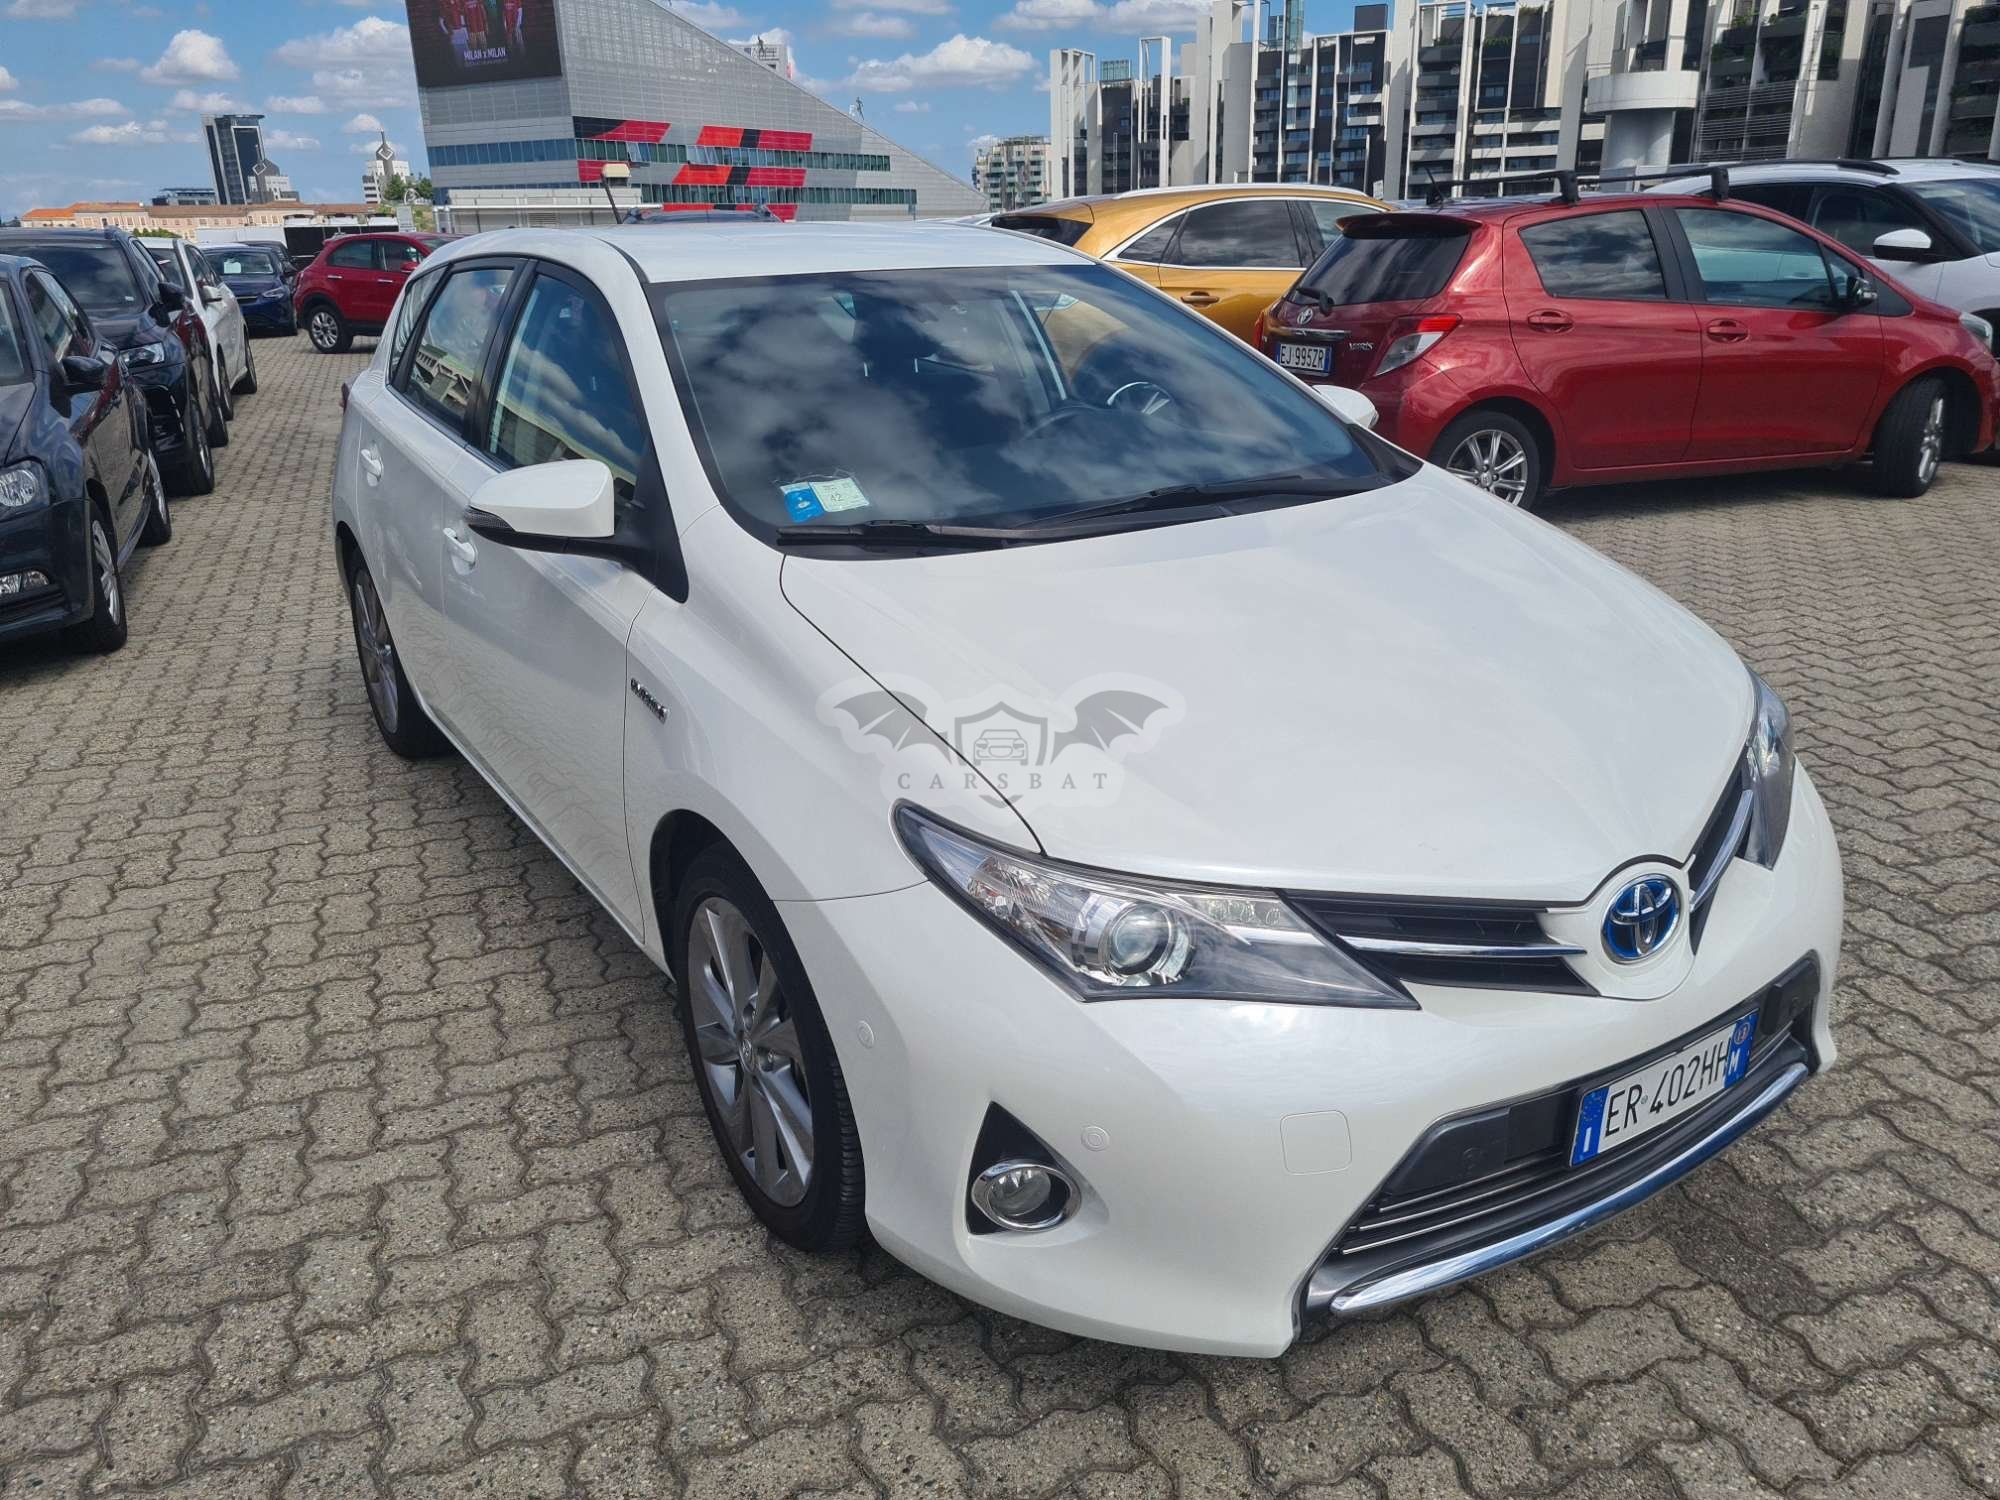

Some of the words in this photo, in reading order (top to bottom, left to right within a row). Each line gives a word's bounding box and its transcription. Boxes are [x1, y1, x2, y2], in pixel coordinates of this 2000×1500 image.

[463, 49, 482, 60] MILAN
[488, 47, 506, 58] MILAN
[1295, 347, 1325, 369] 995ZR
[1604, 1084, 1643, 1138] ER
[1649, 1037, 1732, 1115] 402HH
